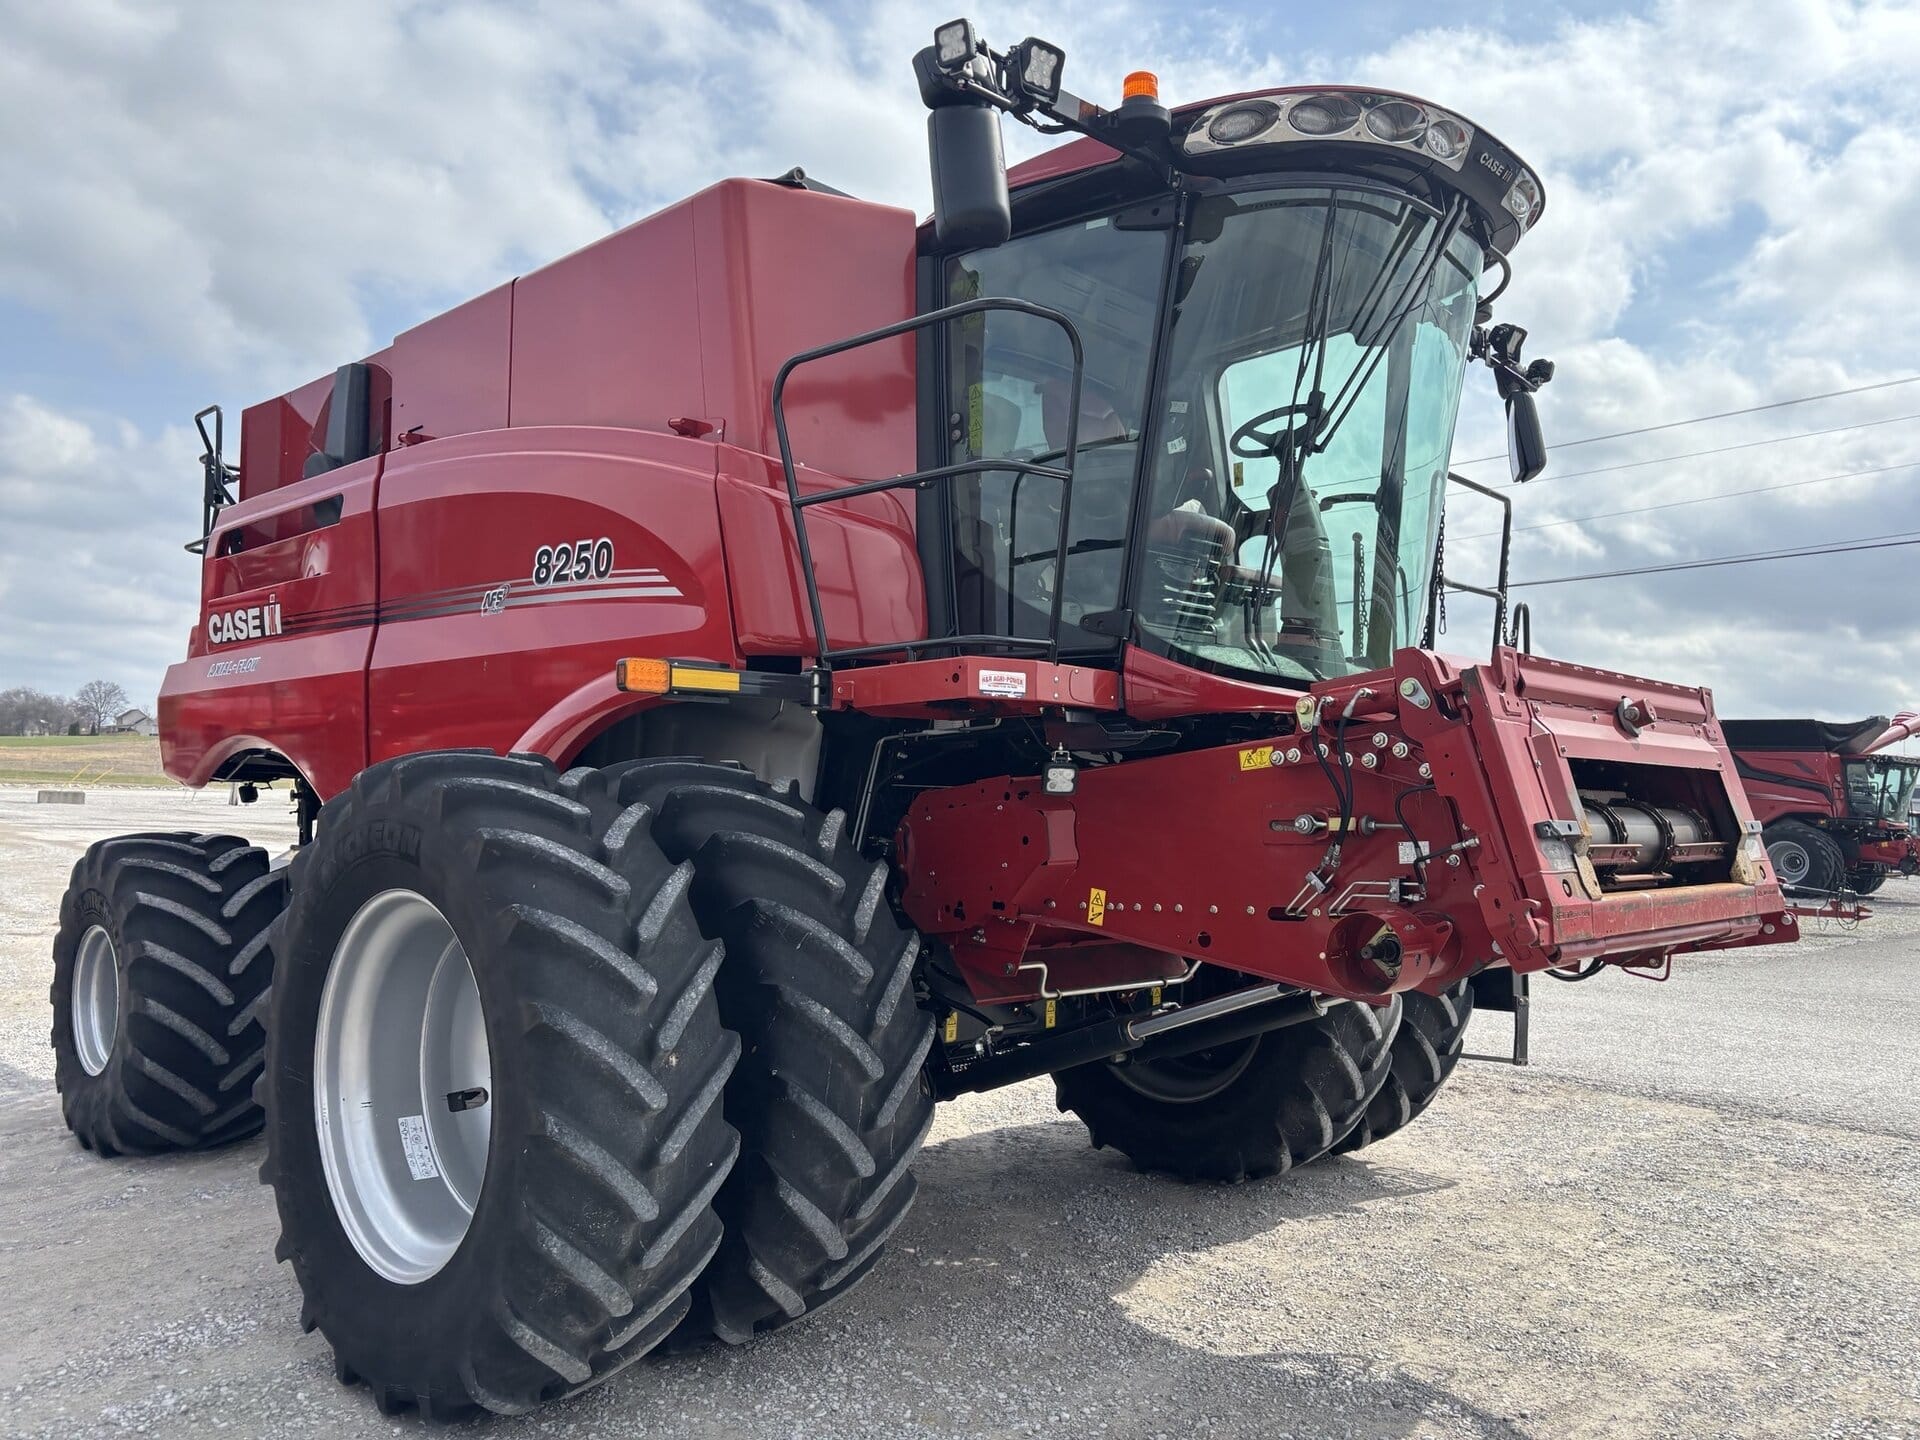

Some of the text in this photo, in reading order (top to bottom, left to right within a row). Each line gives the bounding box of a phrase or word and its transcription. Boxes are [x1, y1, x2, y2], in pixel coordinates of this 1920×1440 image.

[1480, 152, 1504, 176] CASE
[533, 537, 614, 587] 8250
[481, 588, 505, 607] AFS
[208, 607, 262, 644] CASE
